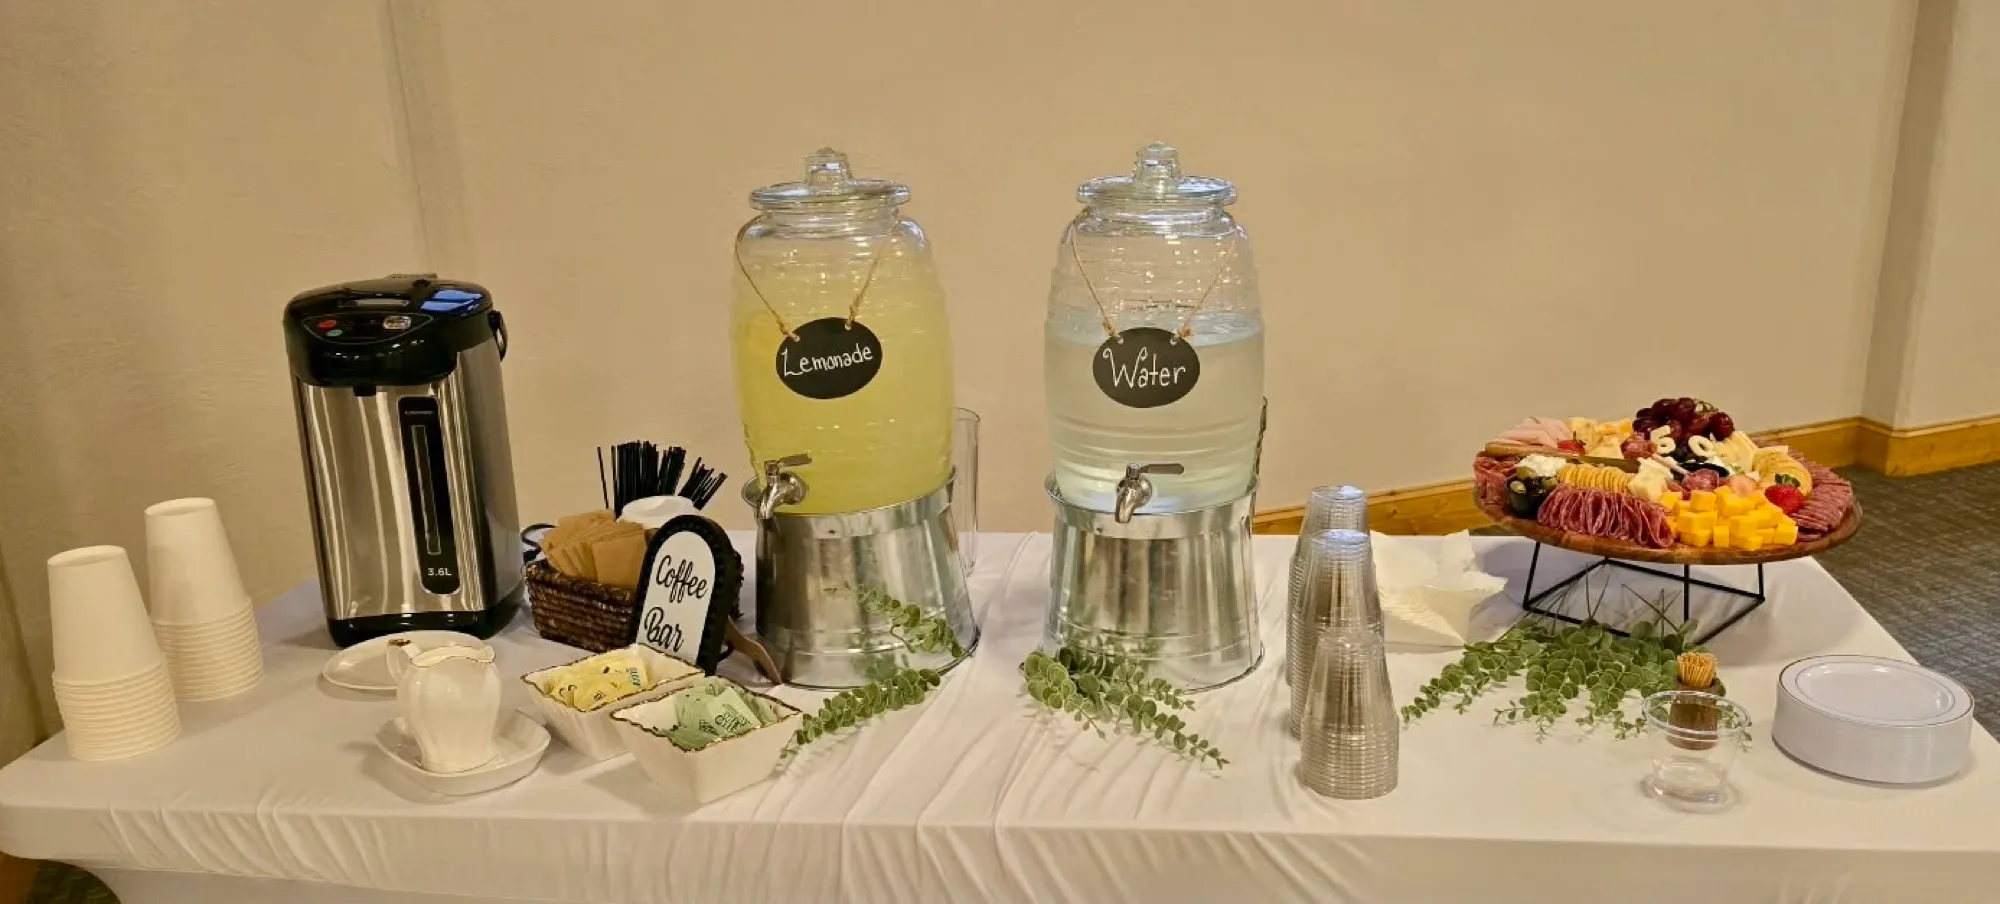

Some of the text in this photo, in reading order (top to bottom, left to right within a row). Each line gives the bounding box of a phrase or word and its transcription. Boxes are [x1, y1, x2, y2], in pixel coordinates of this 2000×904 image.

[781, 343, 873, 376] Lemonade
[1102, 346, 1186, 389] Water
[427, 567, 452, 576] 3.6L
[655, 554, 708, 603] Coffee
[644, 606, 684, 653] Bar
